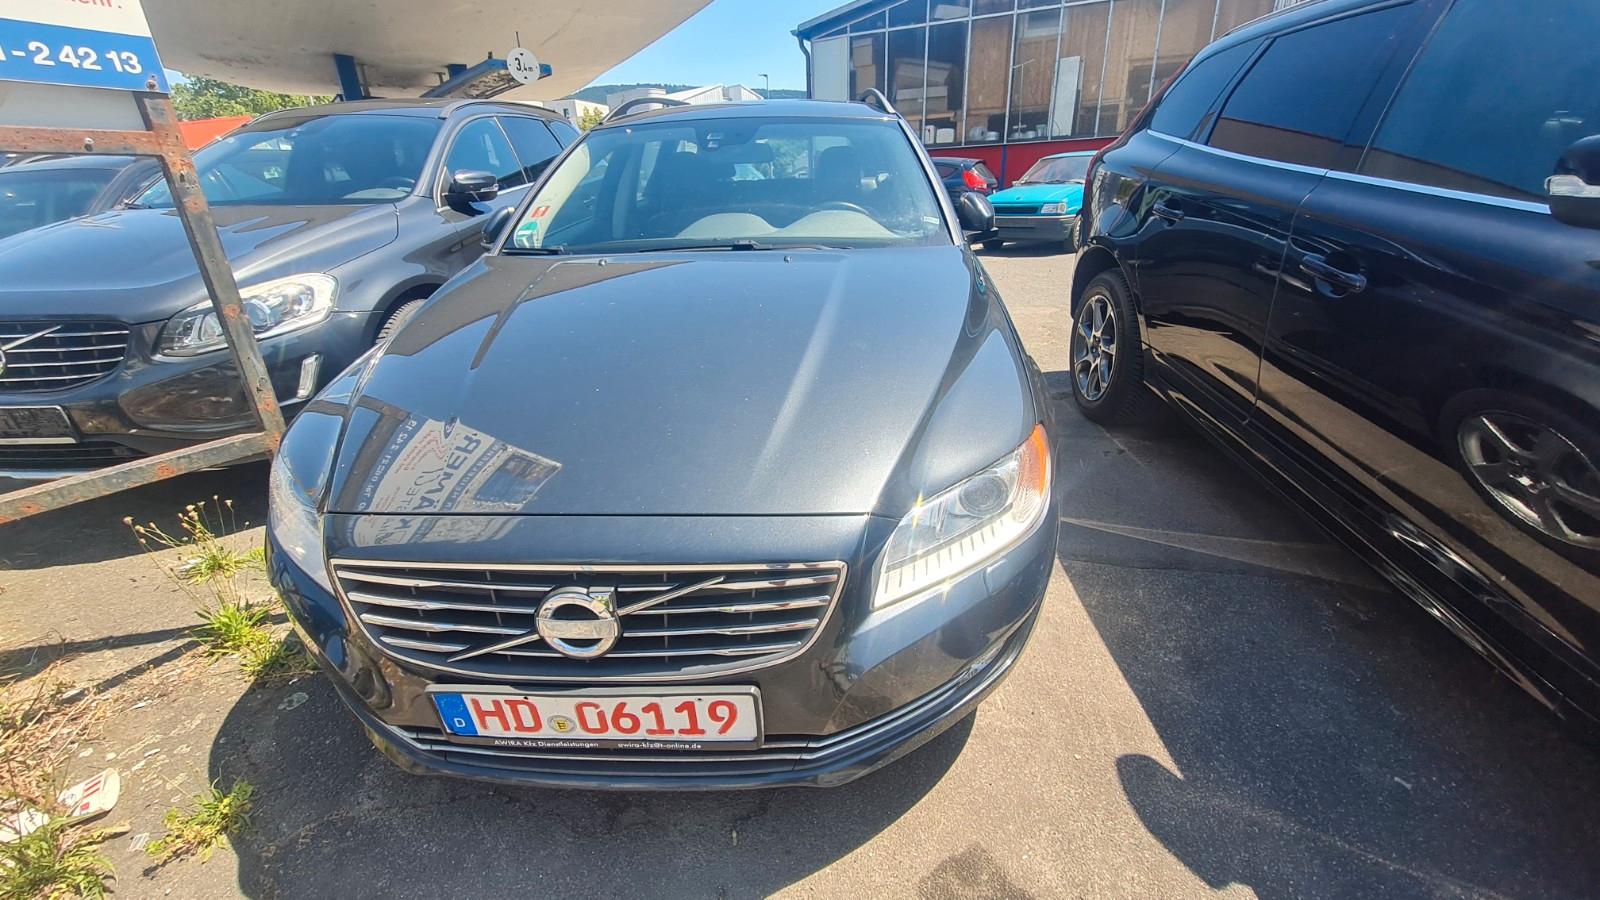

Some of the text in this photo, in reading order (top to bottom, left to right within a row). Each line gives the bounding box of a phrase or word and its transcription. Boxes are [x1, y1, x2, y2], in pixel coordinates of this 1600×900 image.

[454, 717, 466, 729] D
[470, 698, 738, 736] HD 06119
